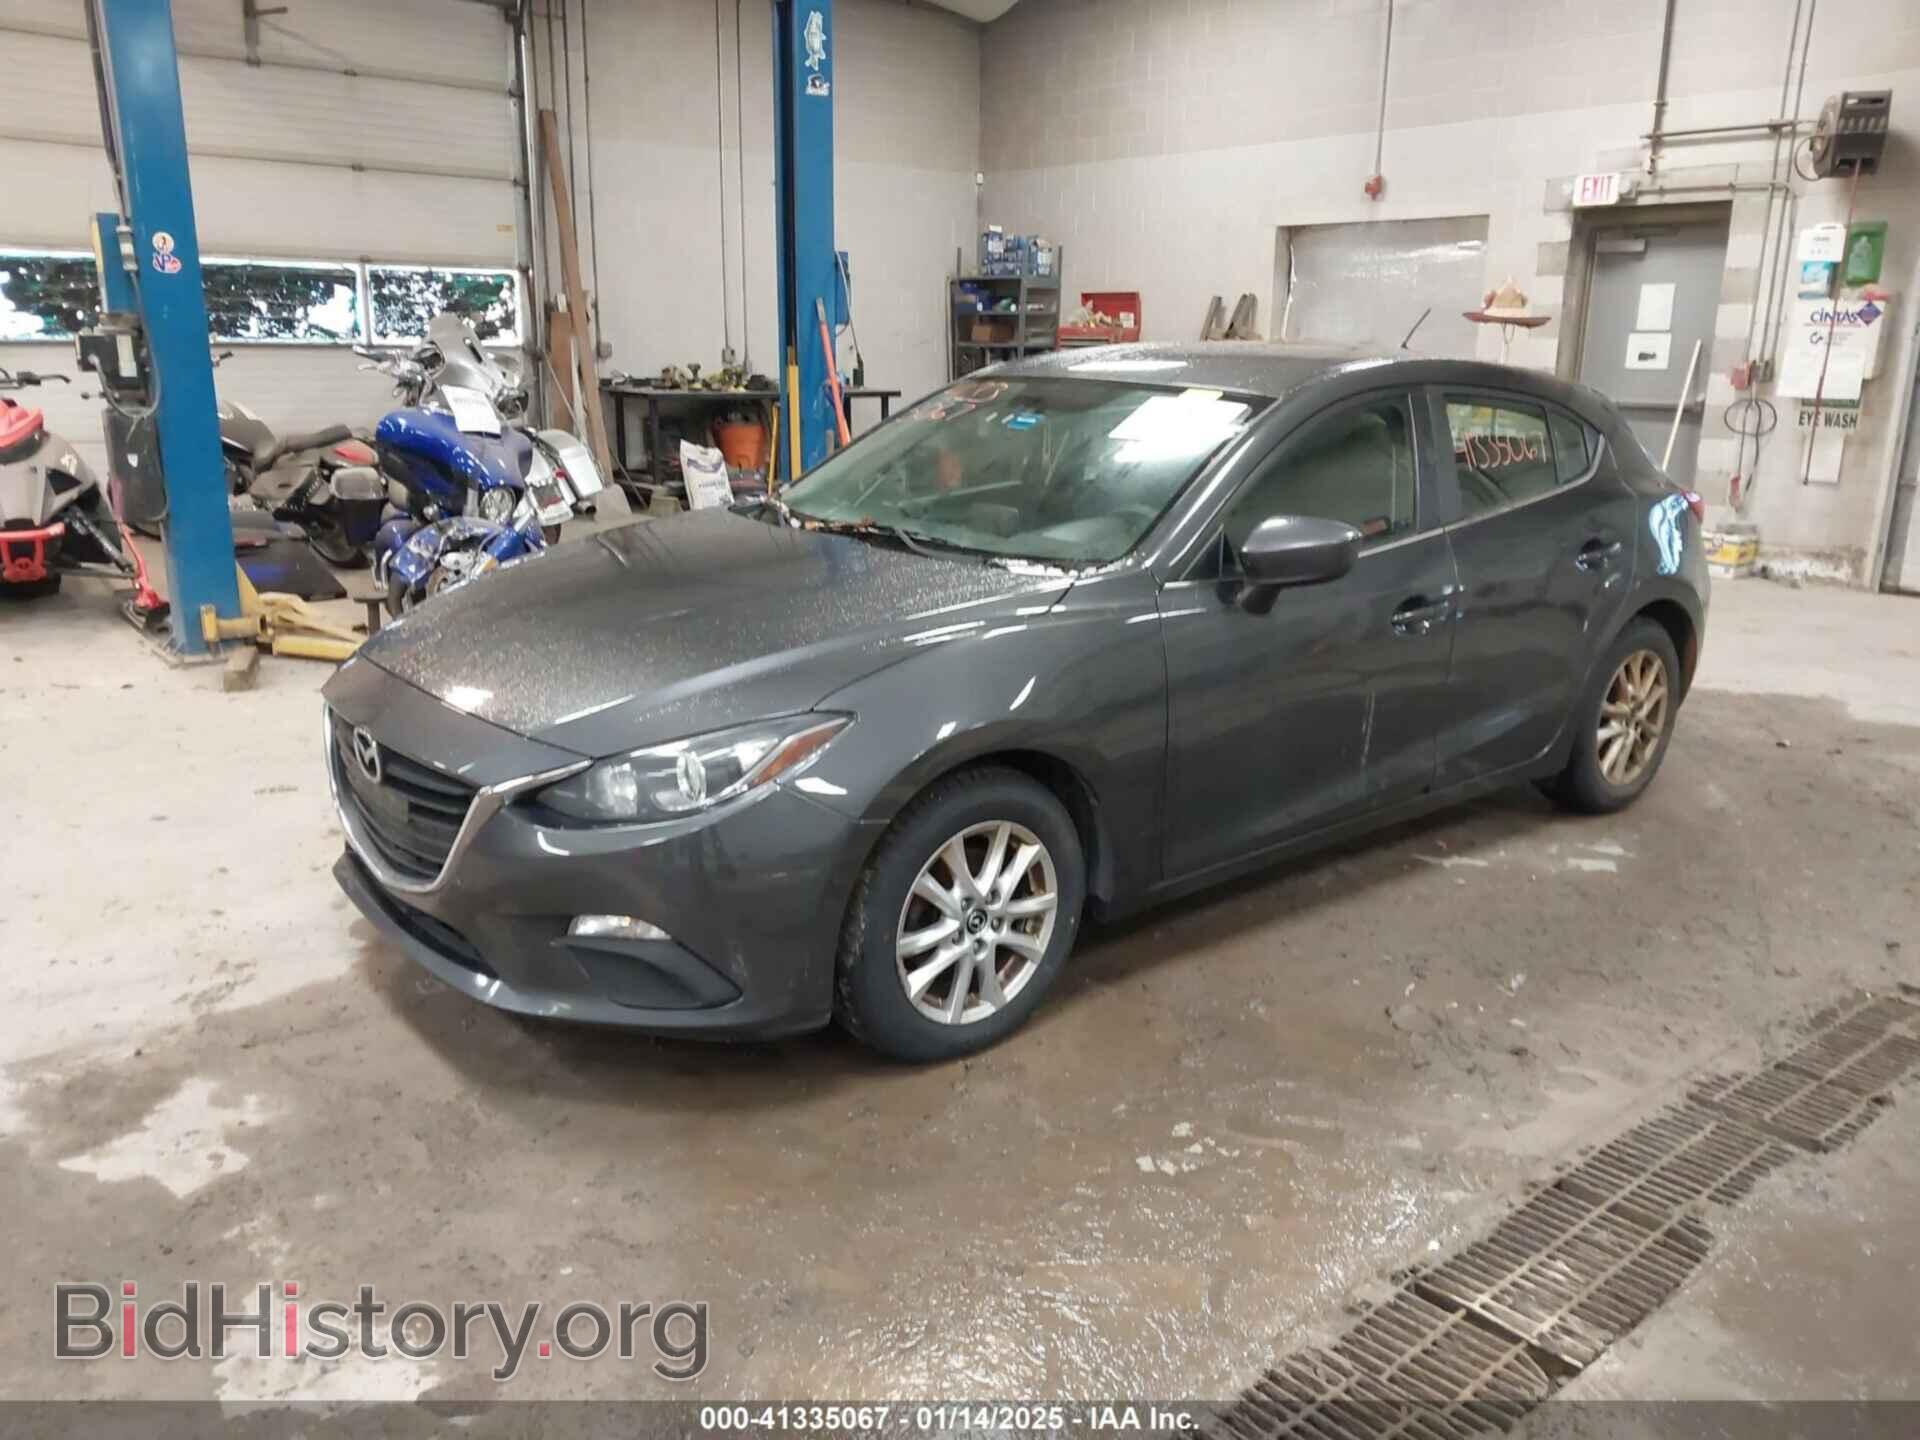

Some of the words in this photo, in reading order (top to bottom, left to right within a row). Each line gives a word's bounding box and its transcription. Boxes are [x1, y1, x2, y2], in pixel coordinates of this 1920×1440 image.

[1581, 175, 1613, 201] EXIT
[1798, 411, 1821, 427] EYE
[1824, 412, 1858, 429] WASH
